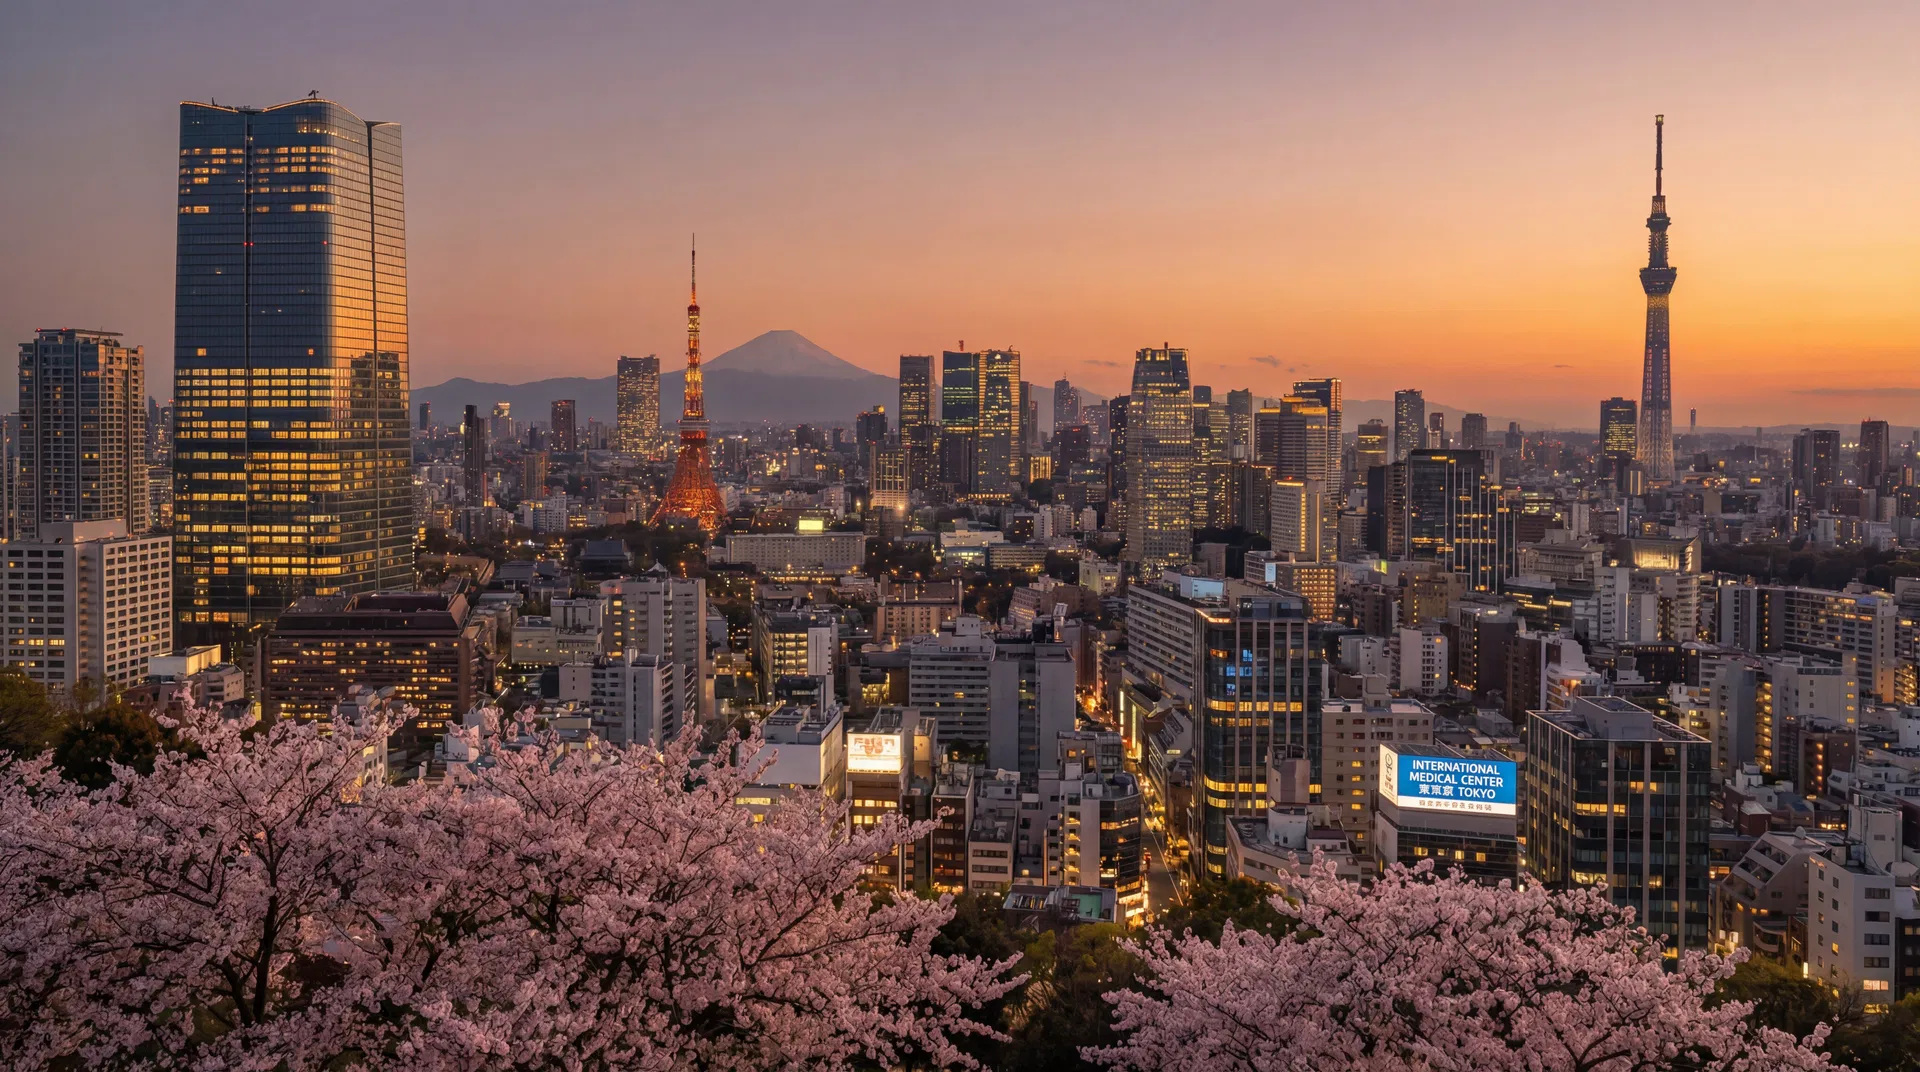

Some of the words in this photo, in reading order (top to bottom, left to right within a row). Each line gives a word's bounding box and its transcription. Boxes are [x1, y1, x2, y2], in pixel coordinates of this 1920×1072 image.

[1412, 759, 1500, 775] INTERNATIONAL
[1409, 771, 1458, 785] MEDICAL
[1460, 774, 1504, 788] CENTER
[1458, 786, 1496, 799] TOKYO
